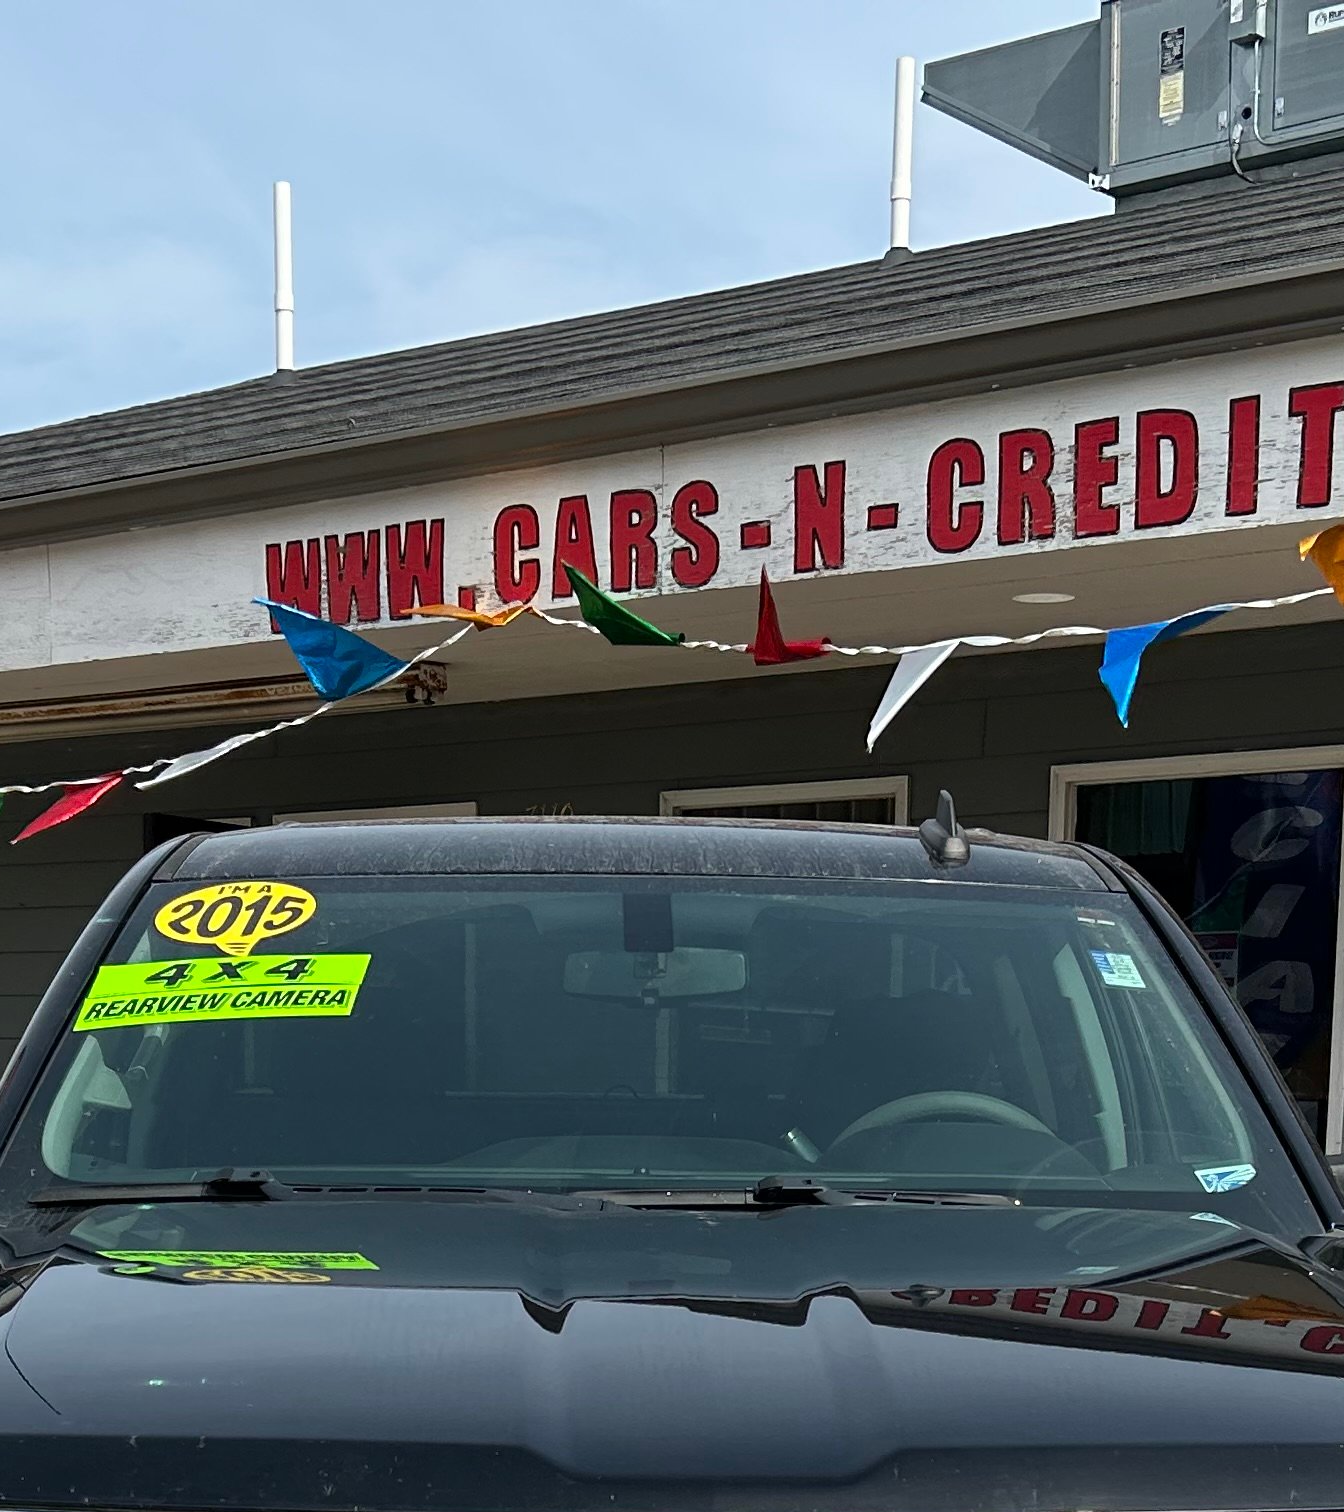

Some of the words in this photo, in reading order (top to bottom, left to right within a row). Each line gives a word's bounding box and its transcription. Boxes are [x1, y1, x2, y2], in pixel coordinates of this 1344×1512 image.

[218, 884, 251, 895] I'M
[256, 884, 272, 895] A
[167, 895, 307, 939] 2015
[83, 992, 228, 1022] REARVIEW
[230, 989, 351, 1012] CAMERA
